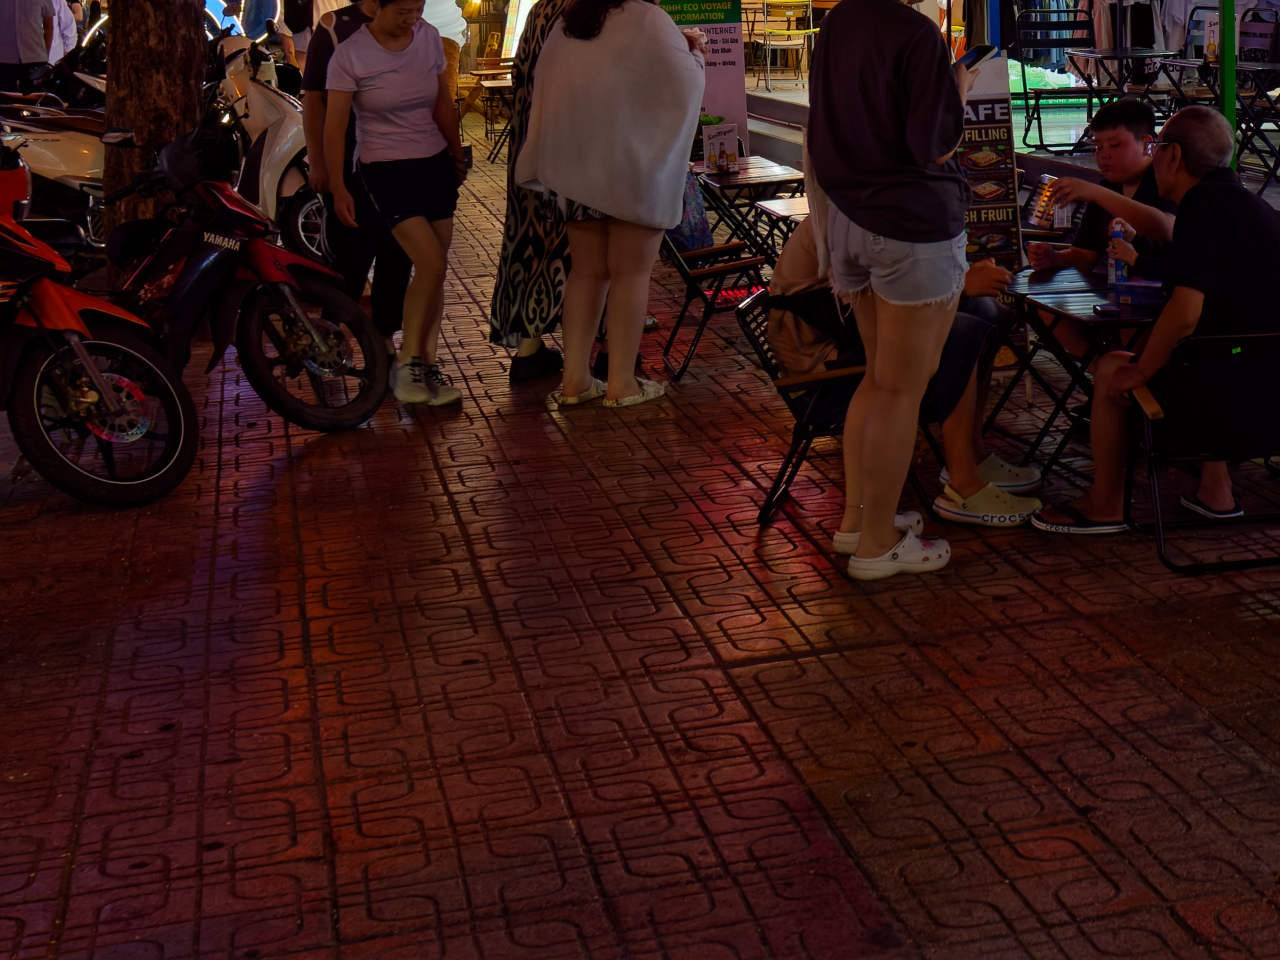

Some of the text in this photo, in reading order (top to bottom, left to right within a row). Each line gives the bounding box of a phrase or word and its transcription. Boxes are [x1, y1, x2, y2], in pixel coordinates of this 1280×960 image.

[684, 3, 698, 11] ECO
[701, 1, 734, 10] VOYAGE
[965, 127, 1008, 143] FILLING
[981, 208, 1014, 222] FRUIT
[203, 231, 241, 252] YAMAHA
[981, 513, 1026, 524] crocs
